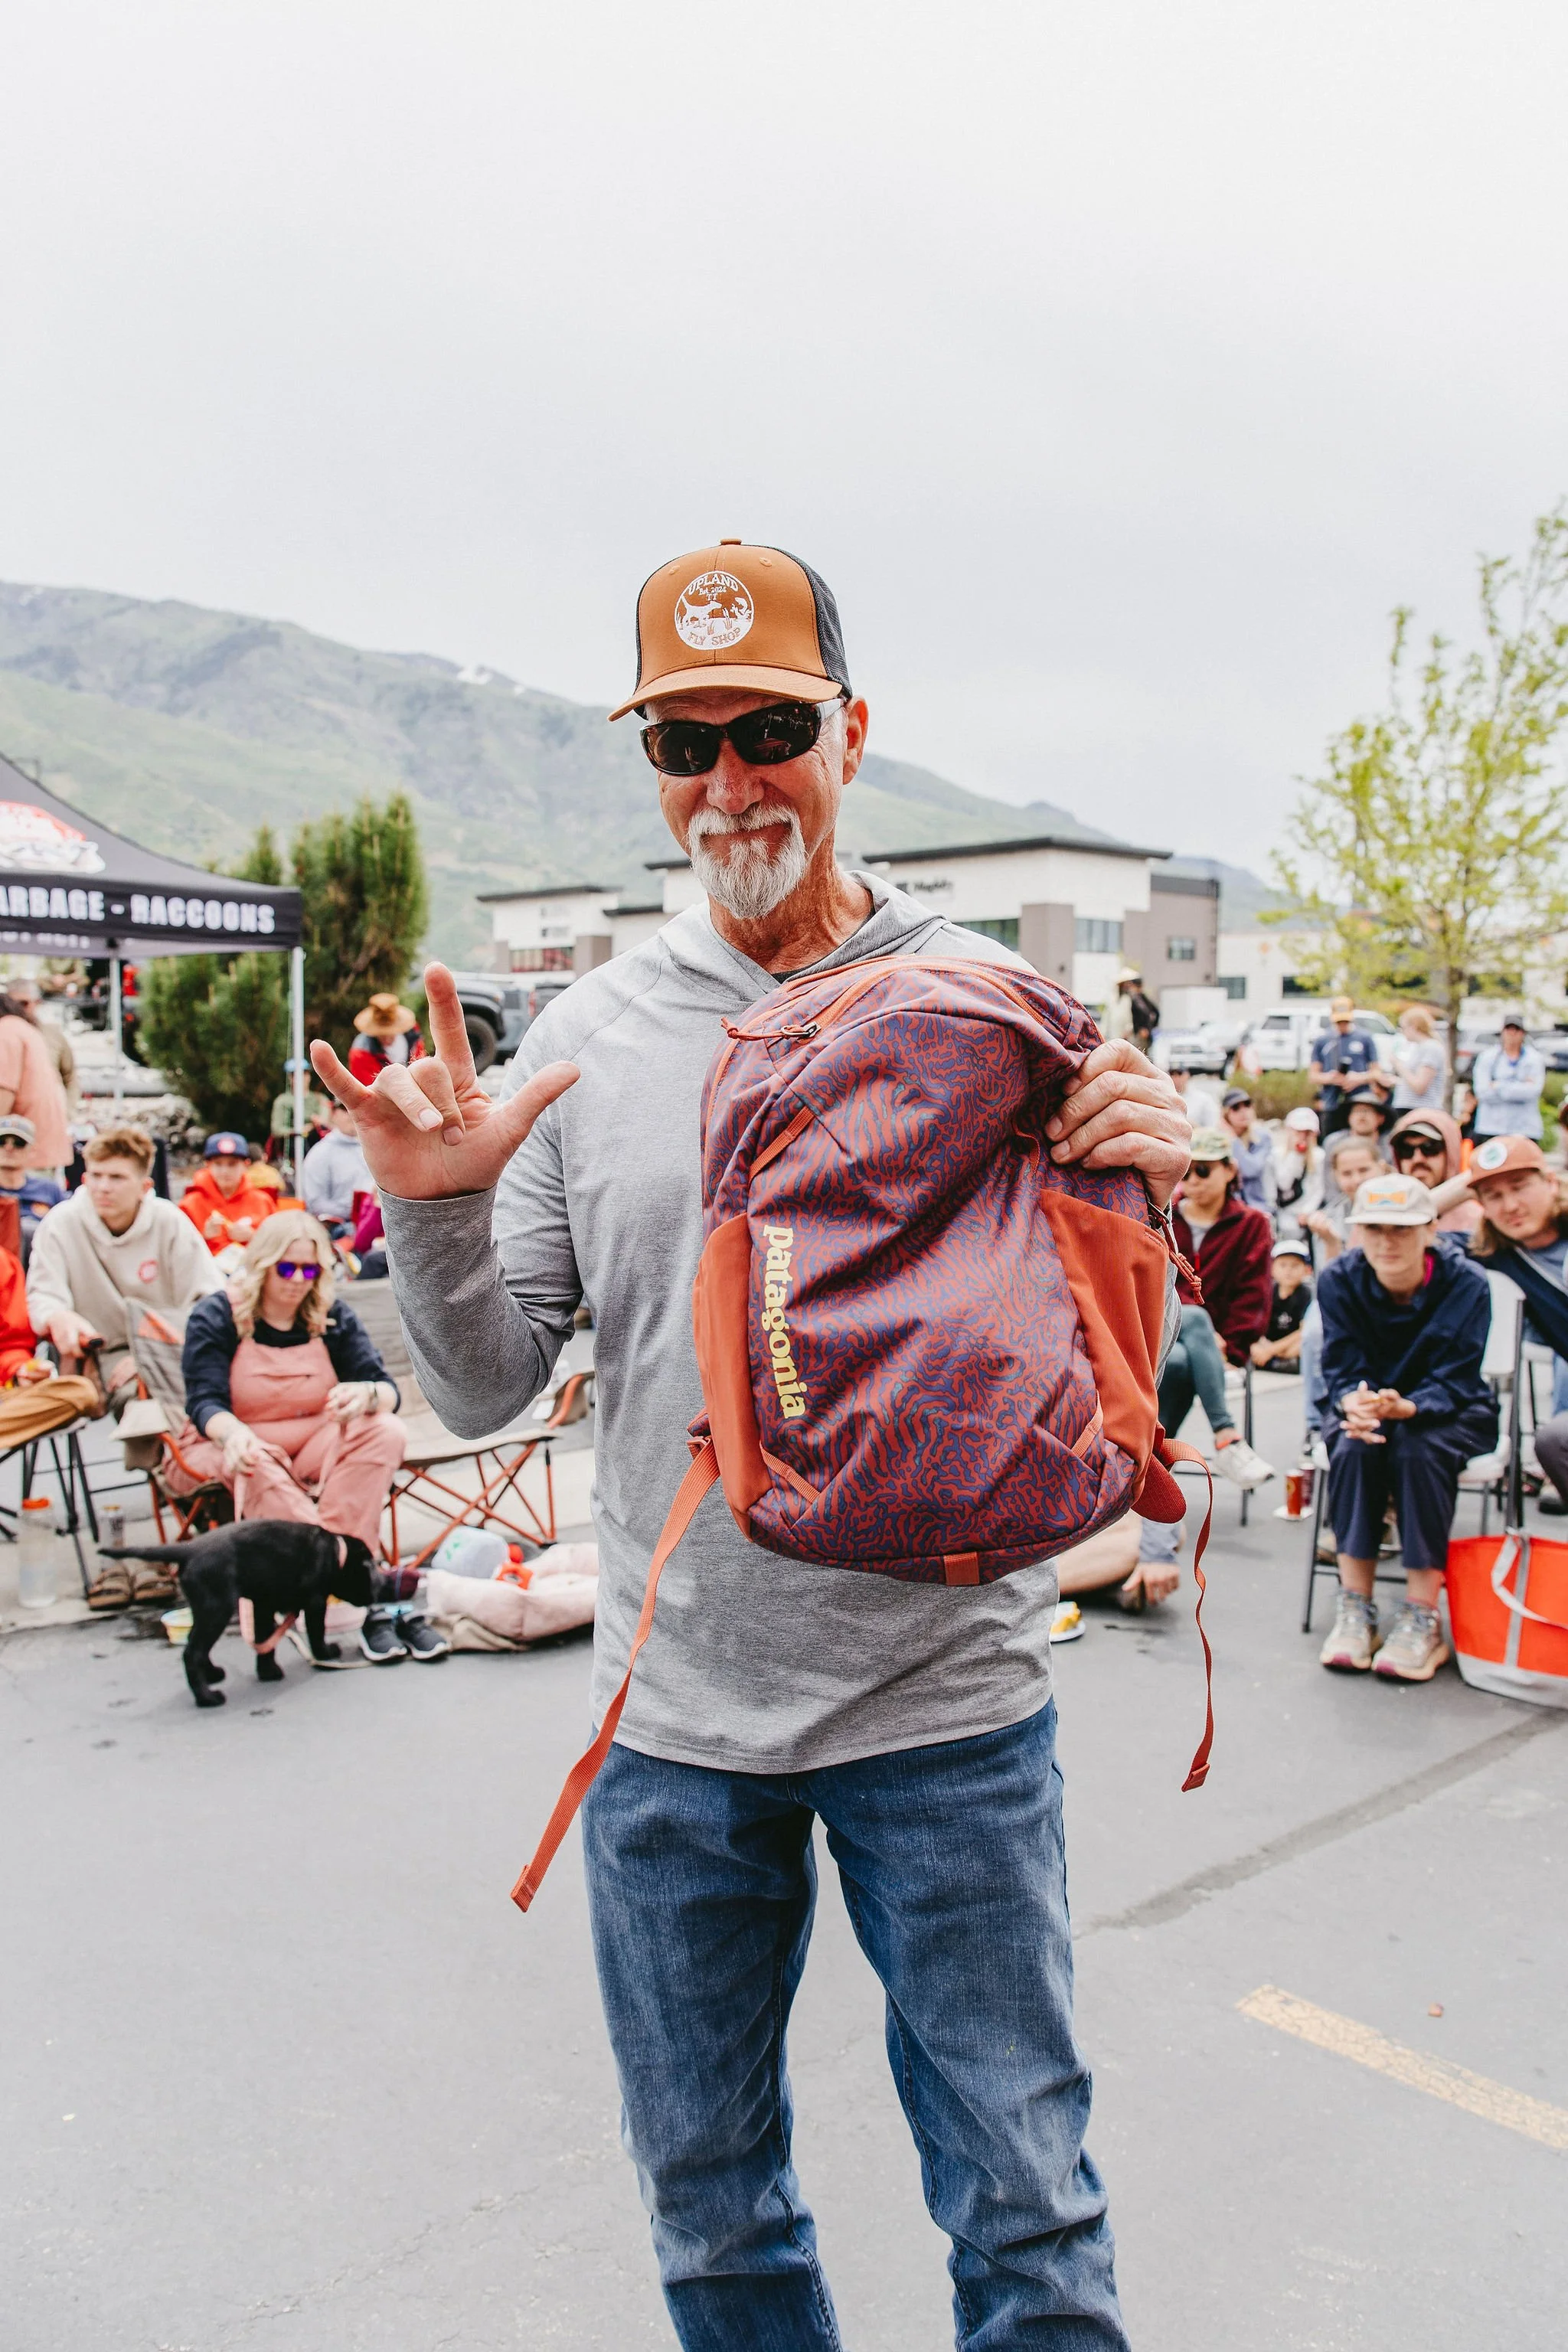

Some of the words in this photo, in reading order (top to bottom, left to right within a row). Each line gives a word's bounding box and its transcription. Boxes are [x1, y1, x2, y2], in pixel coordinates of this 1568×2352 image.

[688, 573, 738, 595] UPLAND
[688, 632, 706, 645] FLY
[711, 627, 741, 645] SHOP
[130, 894, 276, 934] RACCOONS
[761, 1224, 808, 1419] patagonia
